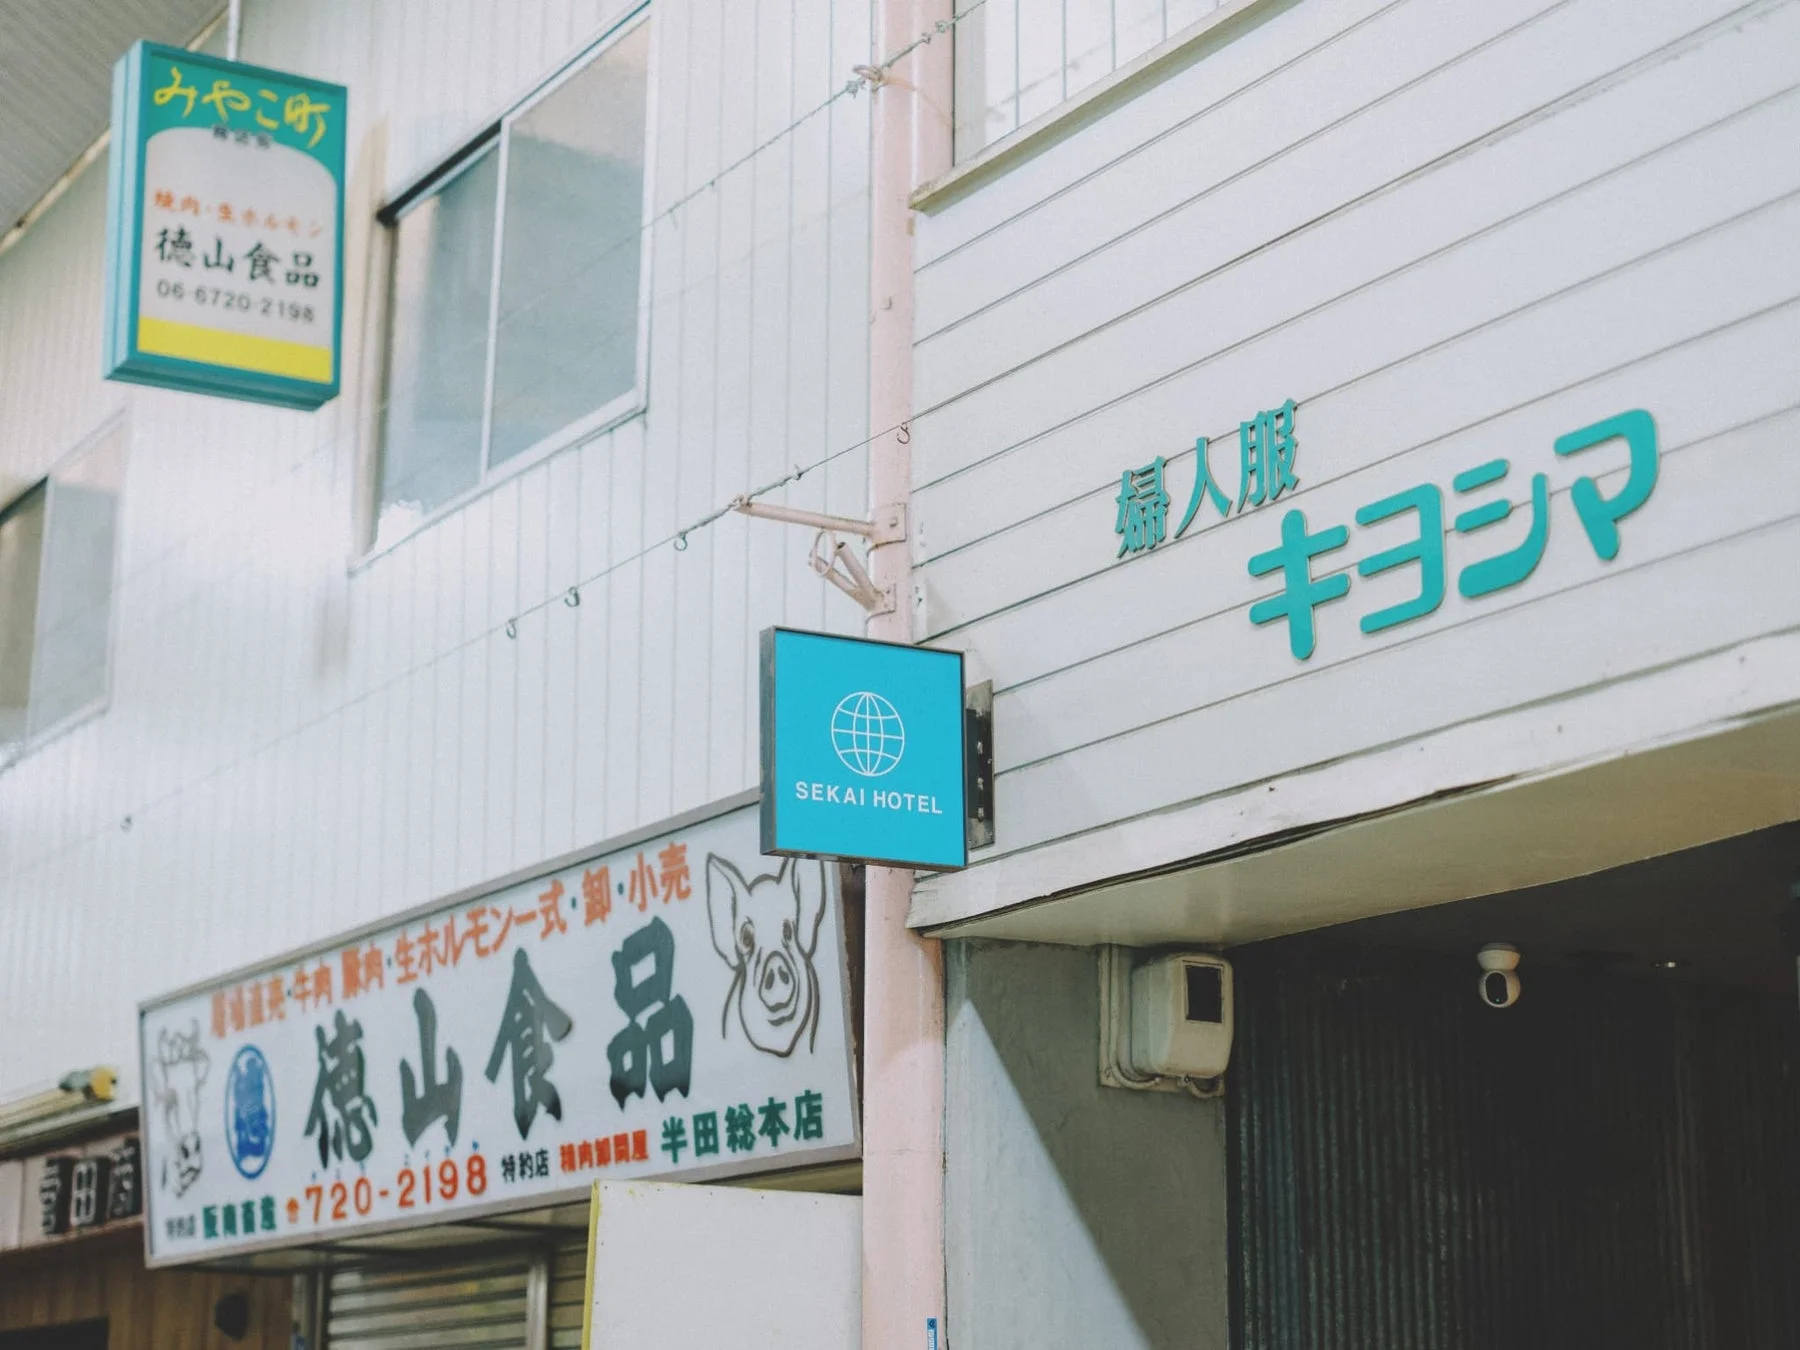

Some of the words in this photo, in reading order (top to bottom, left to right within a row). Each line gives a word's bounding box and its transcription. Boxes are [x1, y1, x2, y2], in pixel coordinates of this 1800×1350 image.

[154, 66, 331, 148] みやこ町
[154, 226, 320, 289] 徳山食品
[1115, 399, 1300, 558] 婦人服
[1248, 409, 1659, 660] キヨシマ
[795, 781, 865, 806] SEKAI
[873, 790, 943, 814] HOTEL
[304, 915, 694, 1168] 徳山食品
[305, 1153, 487, 1224] 720-2198
[661, 1089, 823, 1164] 半田総本店
